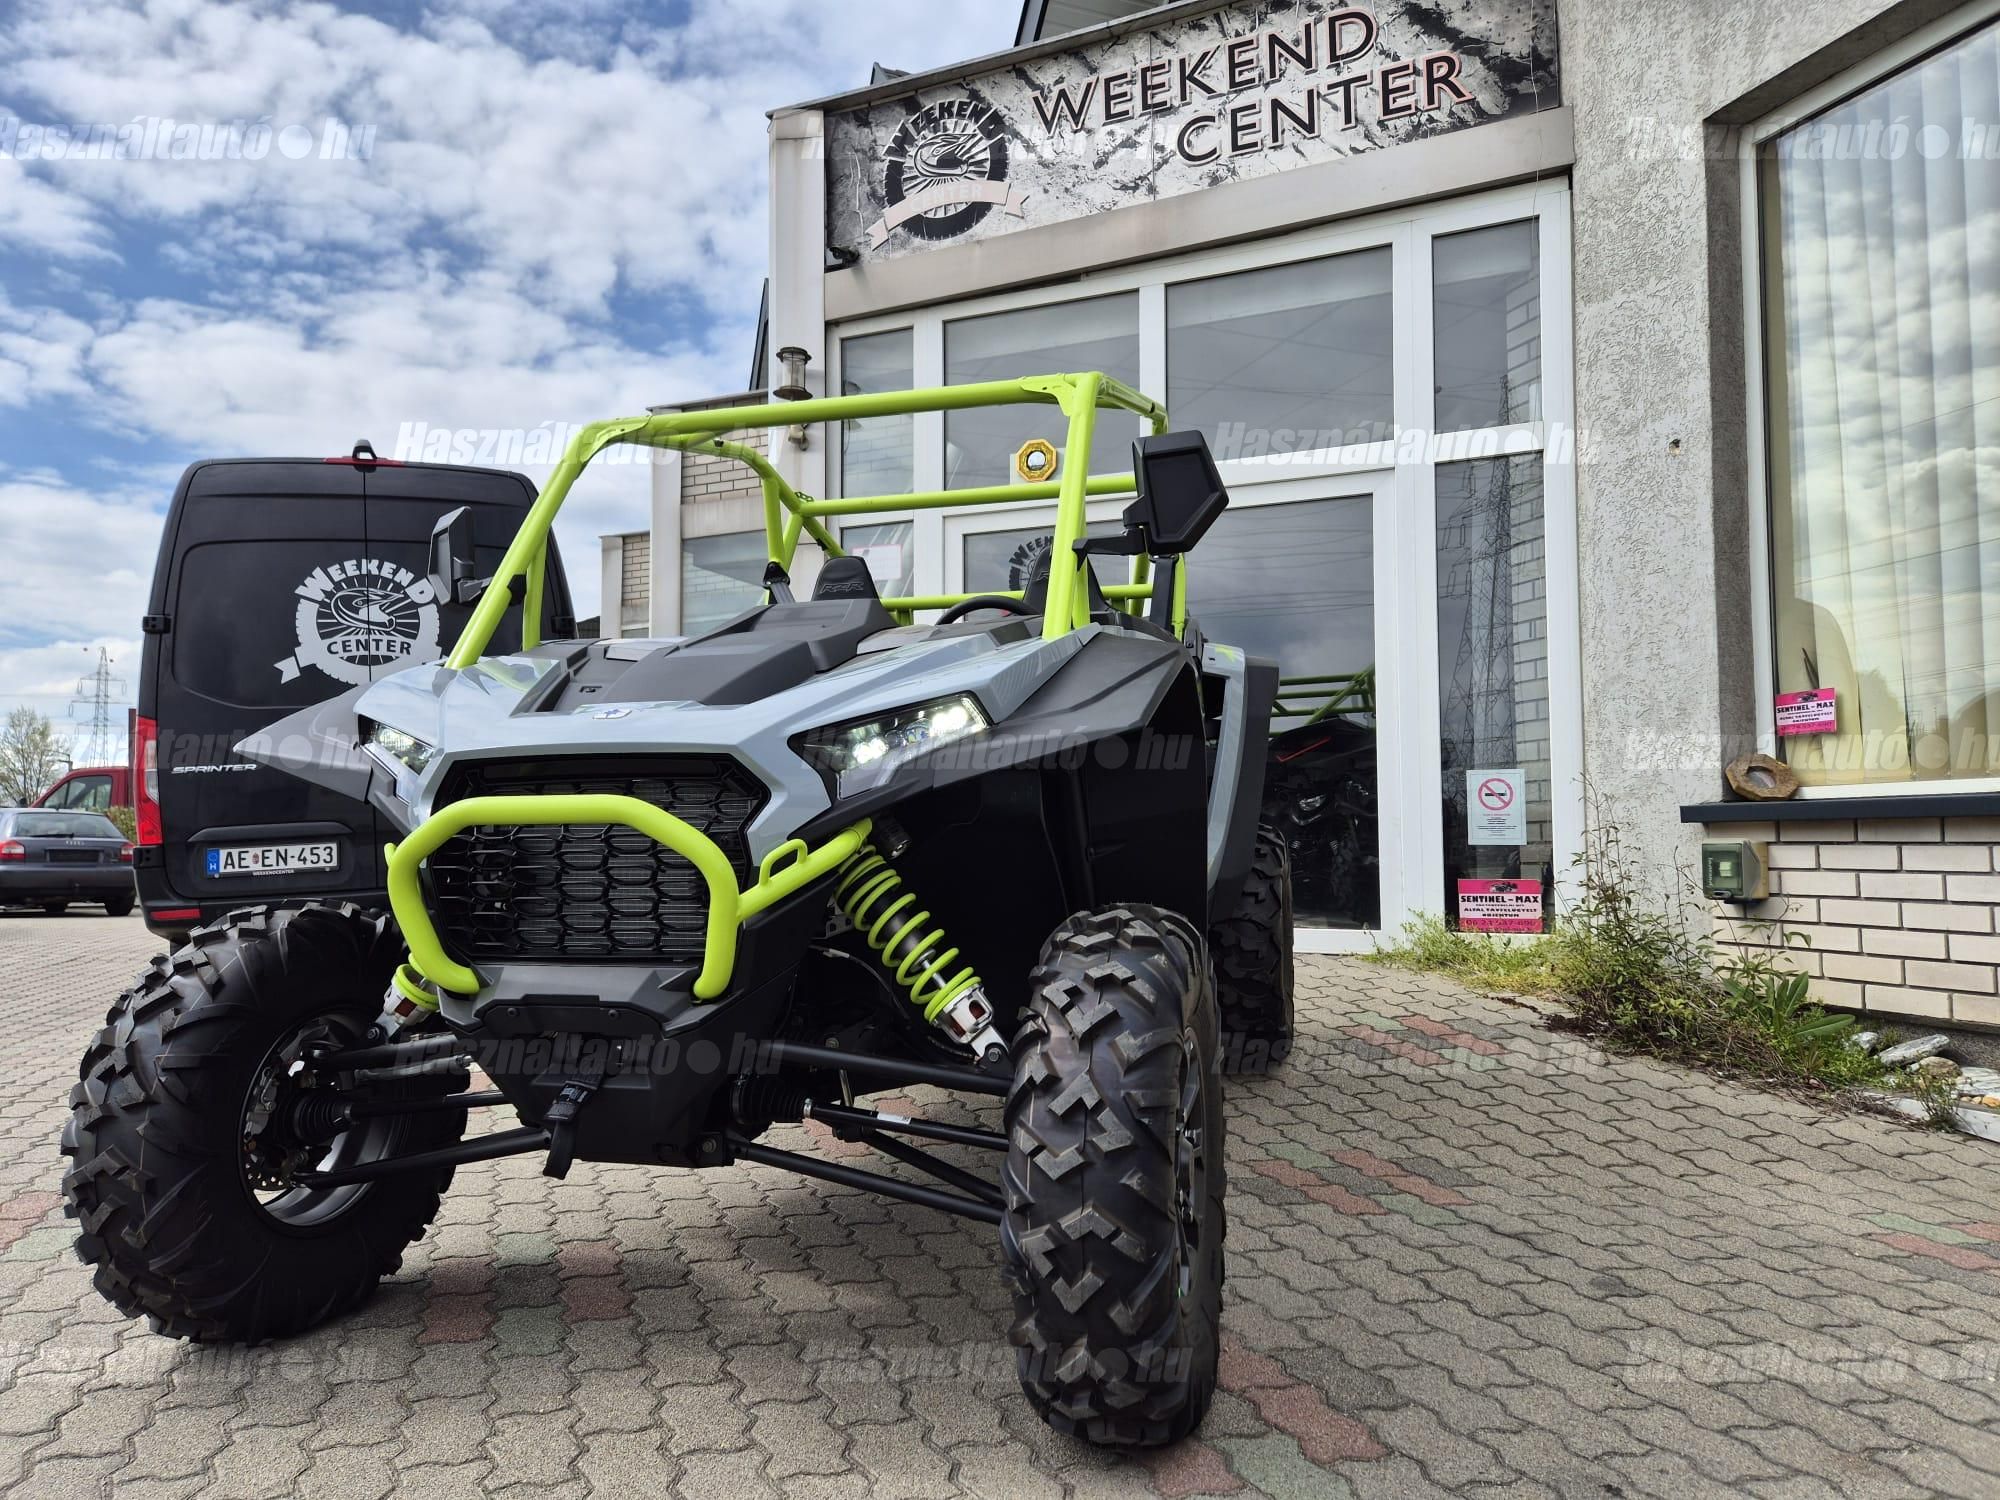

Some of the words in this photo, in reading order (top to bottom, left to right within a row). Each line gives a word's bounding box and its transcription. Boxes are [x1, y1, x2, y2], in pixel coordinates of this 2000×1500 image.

[1031, 7, 1378, 138] WEEKEND
[1176, 50, 1476, 167] CENTER
[294, 558, 435, 605] WEEKEND
[326, 638, 413, 656] CENTER
[1777, 704, 1809, 713] SENTINEL
[172, 763, 257, 775] SPRINTER
[223, 850, 250, 870] AE
[261, 846, 334, 868] EN-453
[1461, 895, 1506, 903] SENTINEL
[1515, 895, 1539, 903] MAX
